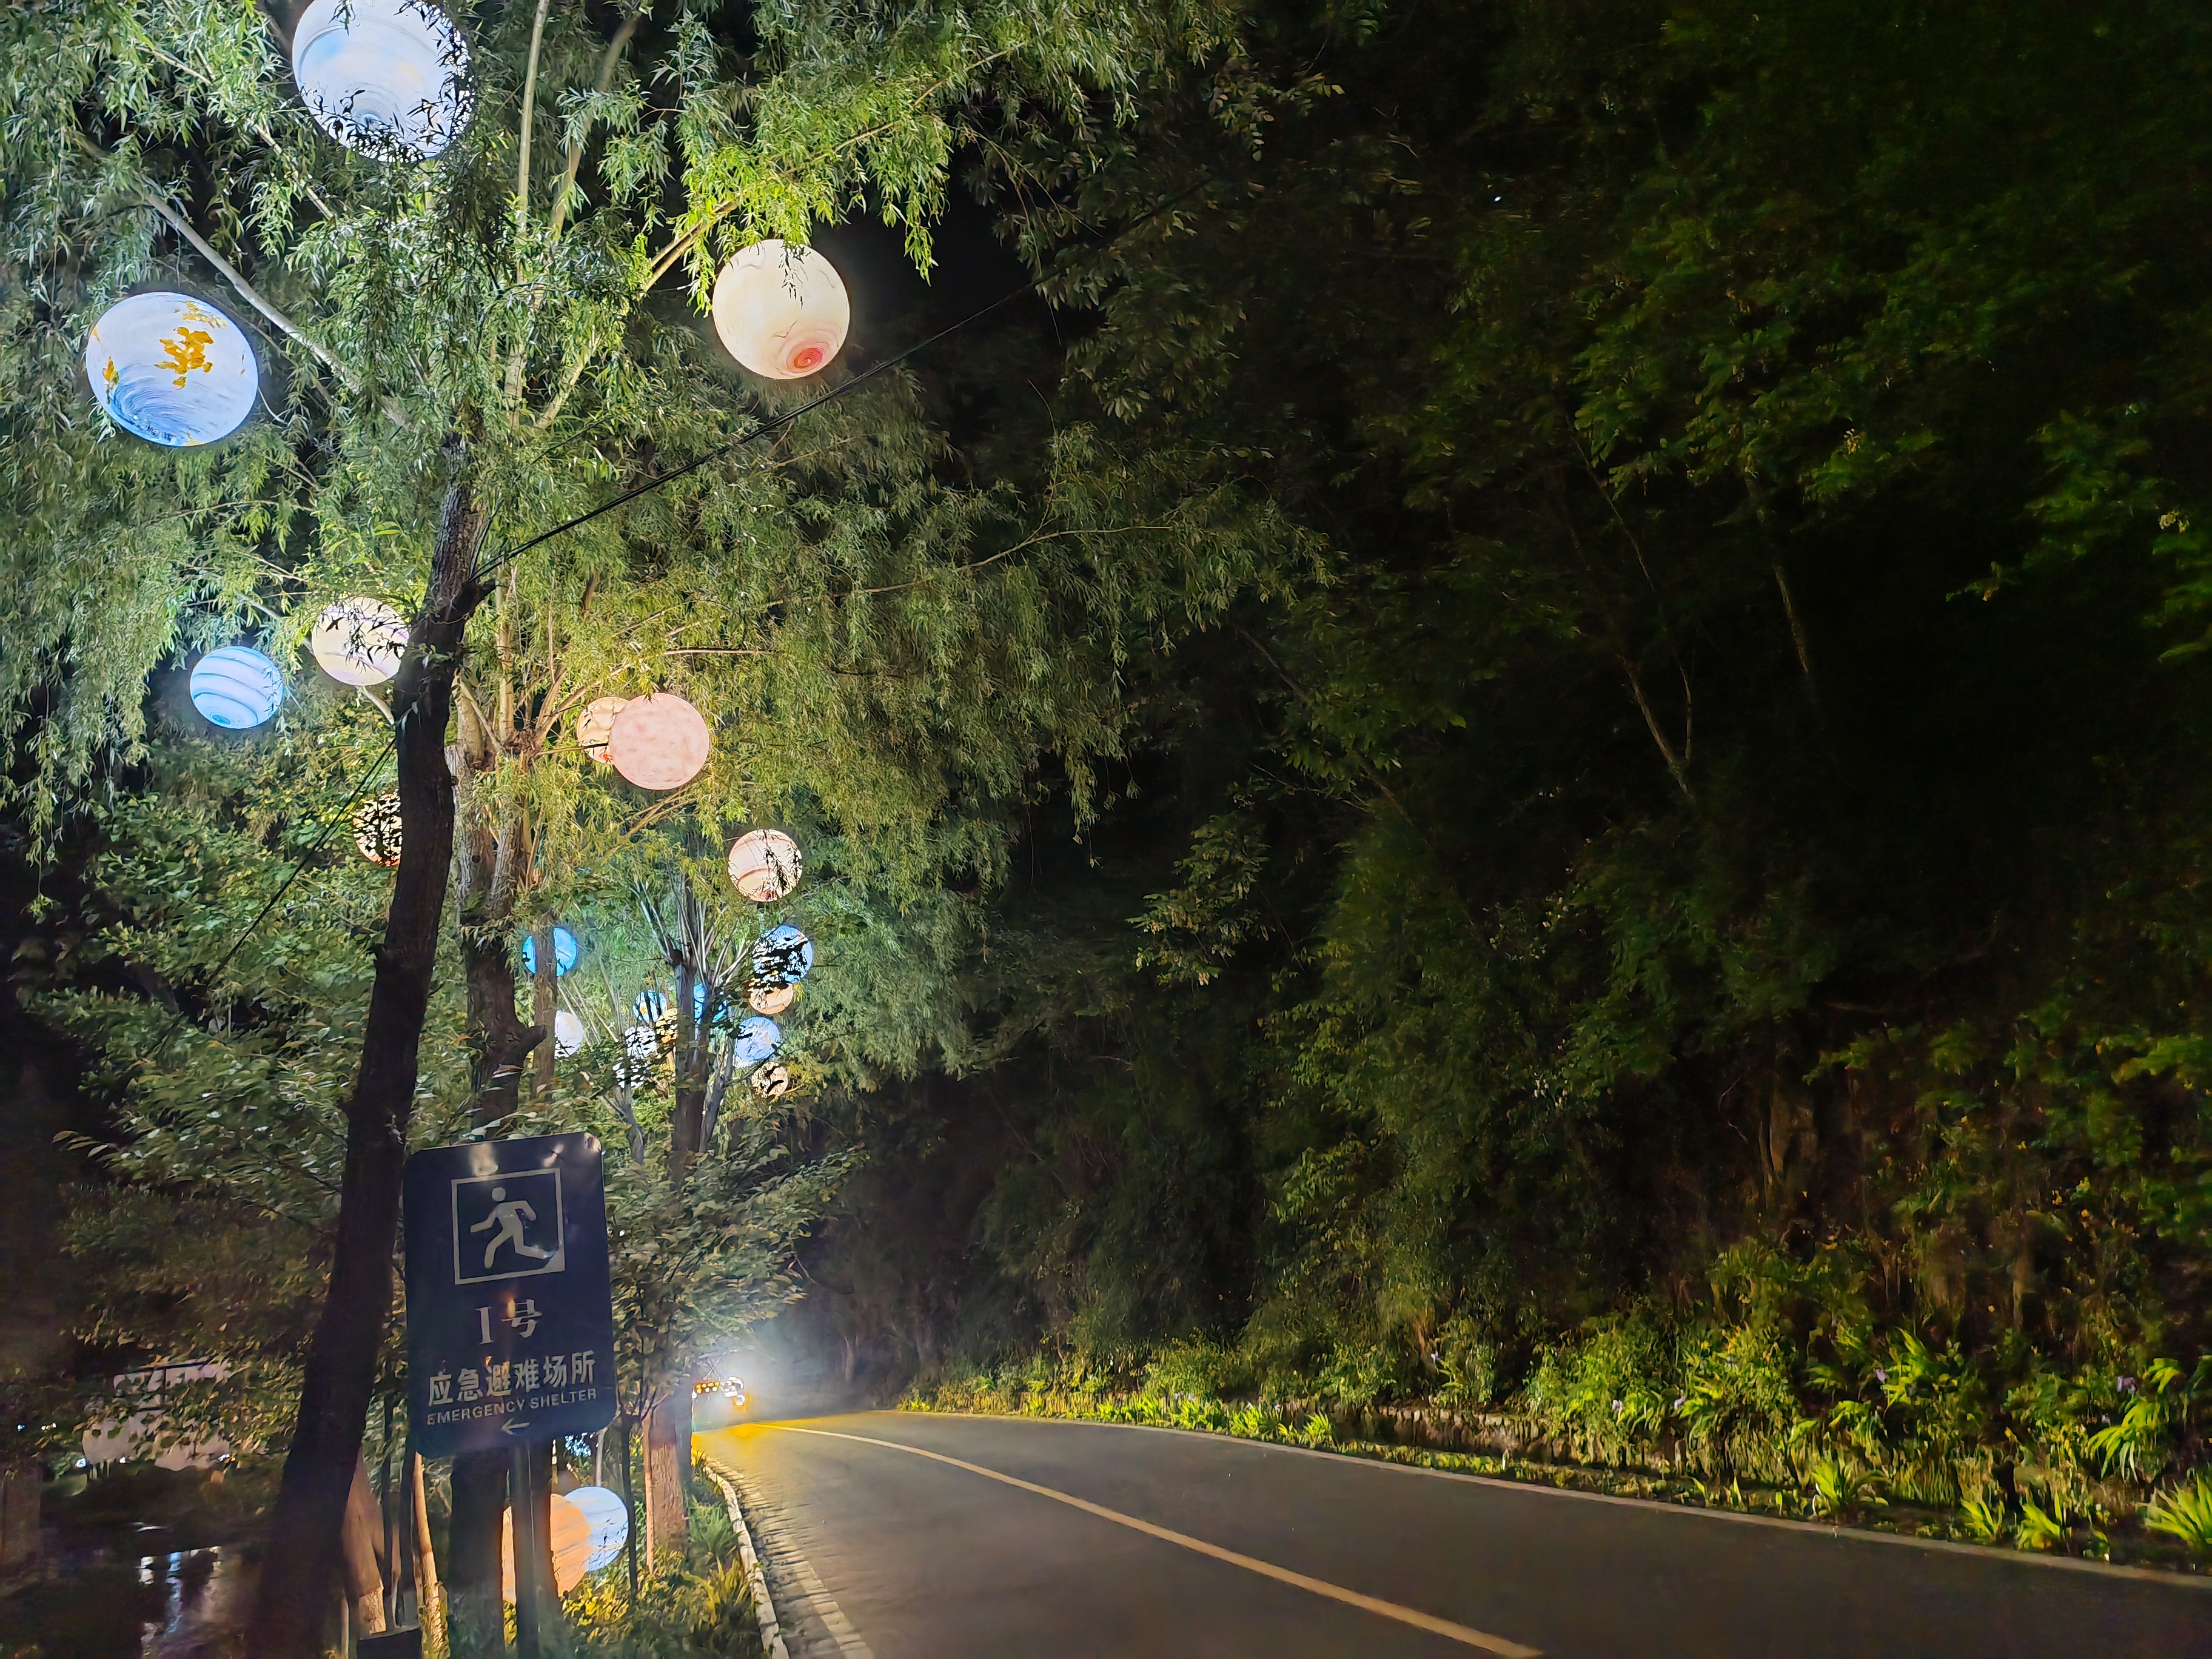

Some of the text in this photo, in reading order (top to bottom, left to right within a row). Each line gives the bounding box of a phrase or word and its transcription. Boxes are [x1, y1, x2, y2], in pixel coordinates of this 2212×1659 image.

[429, 1350, 595, 1407] 应急避难场所
[427, 1388, 597, 1426] EMERGENCY SHELTER
